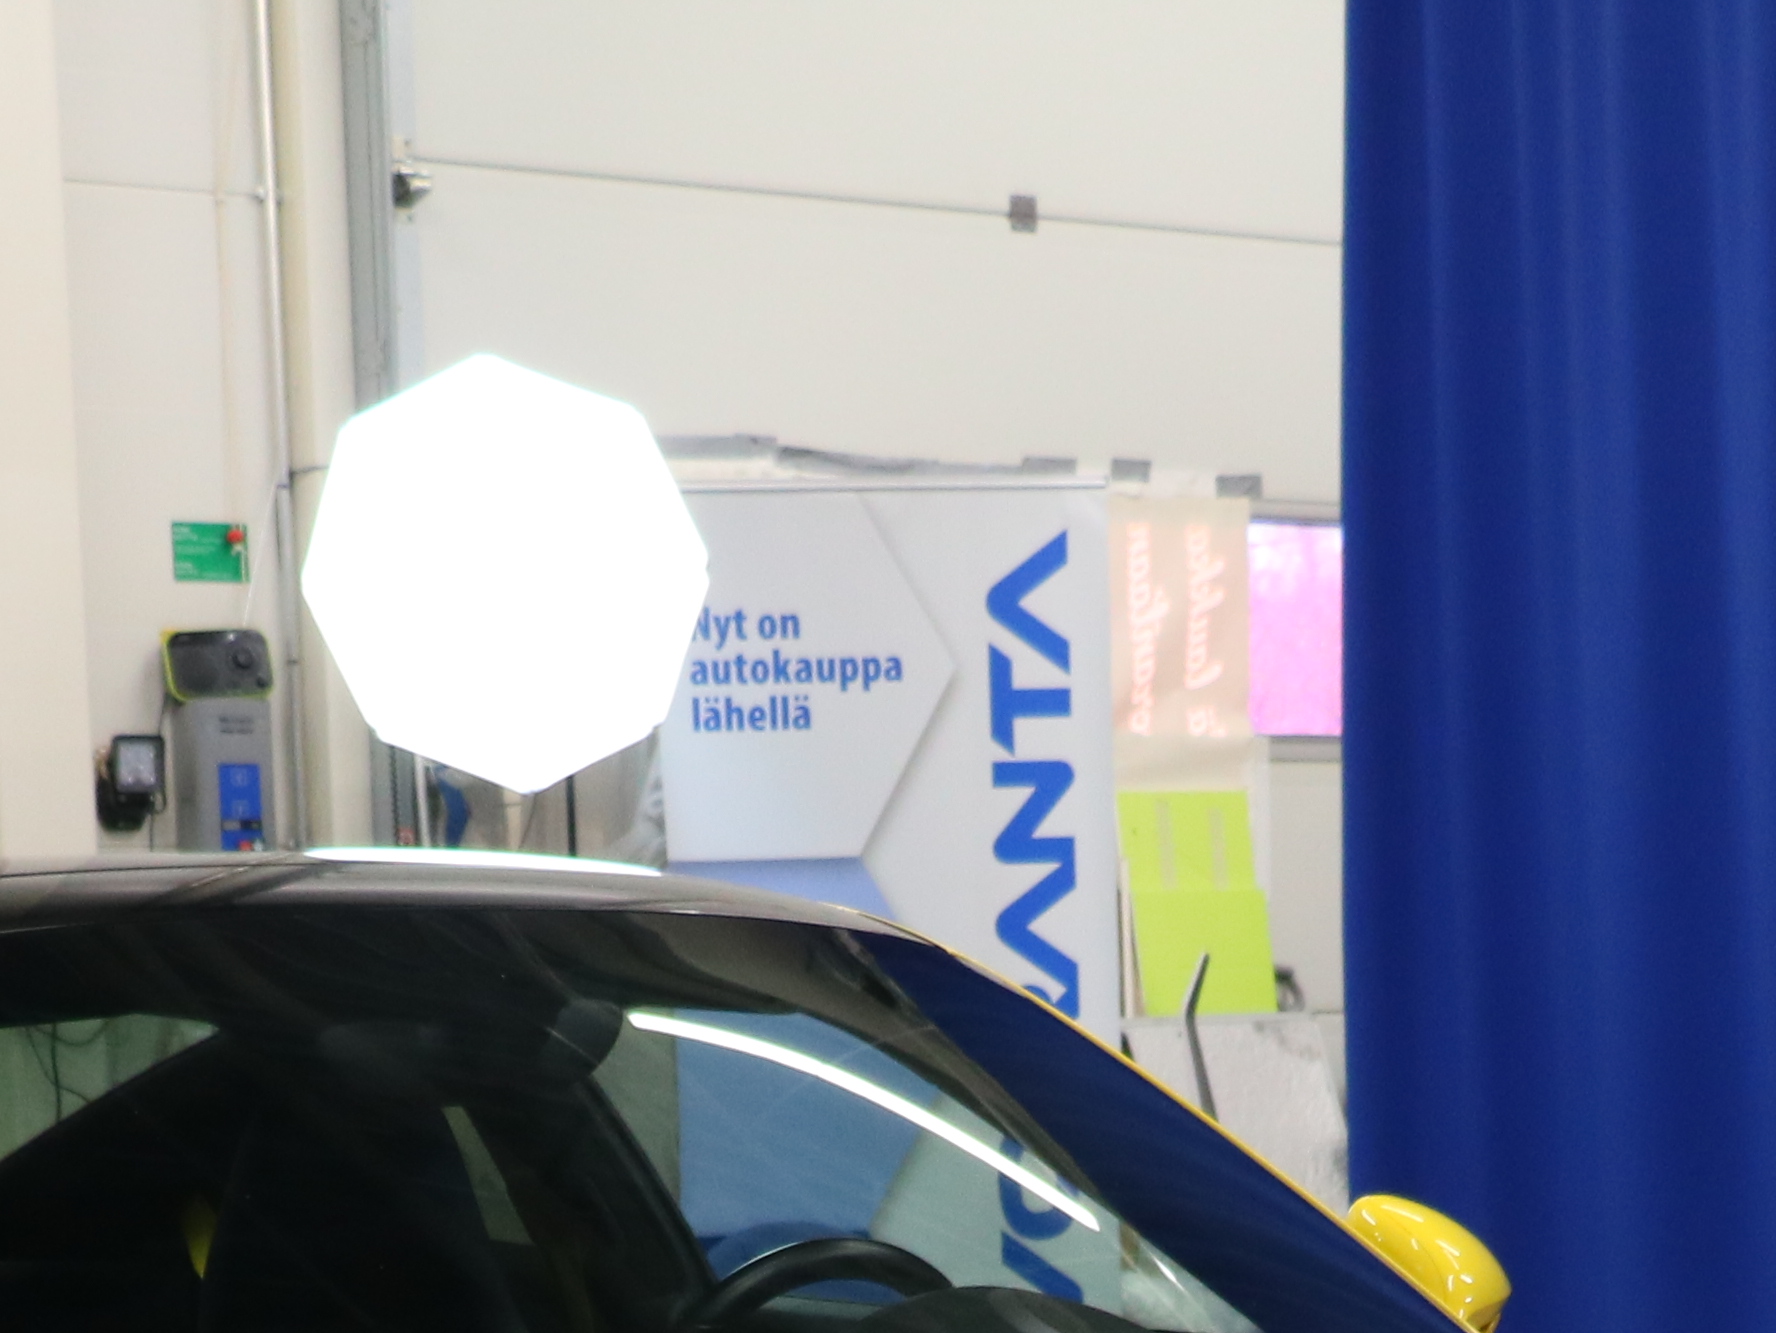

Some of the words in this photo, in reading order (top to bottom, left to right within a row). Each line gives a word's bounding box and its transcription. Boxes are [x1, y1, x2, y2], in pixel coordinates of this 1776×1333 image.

[691, 606, 747, 651] Nyt
[758, 613, 801, 640] on
[690, 648, 903, 692] autokauppa
[691, 694, 811, 732] lähellä
